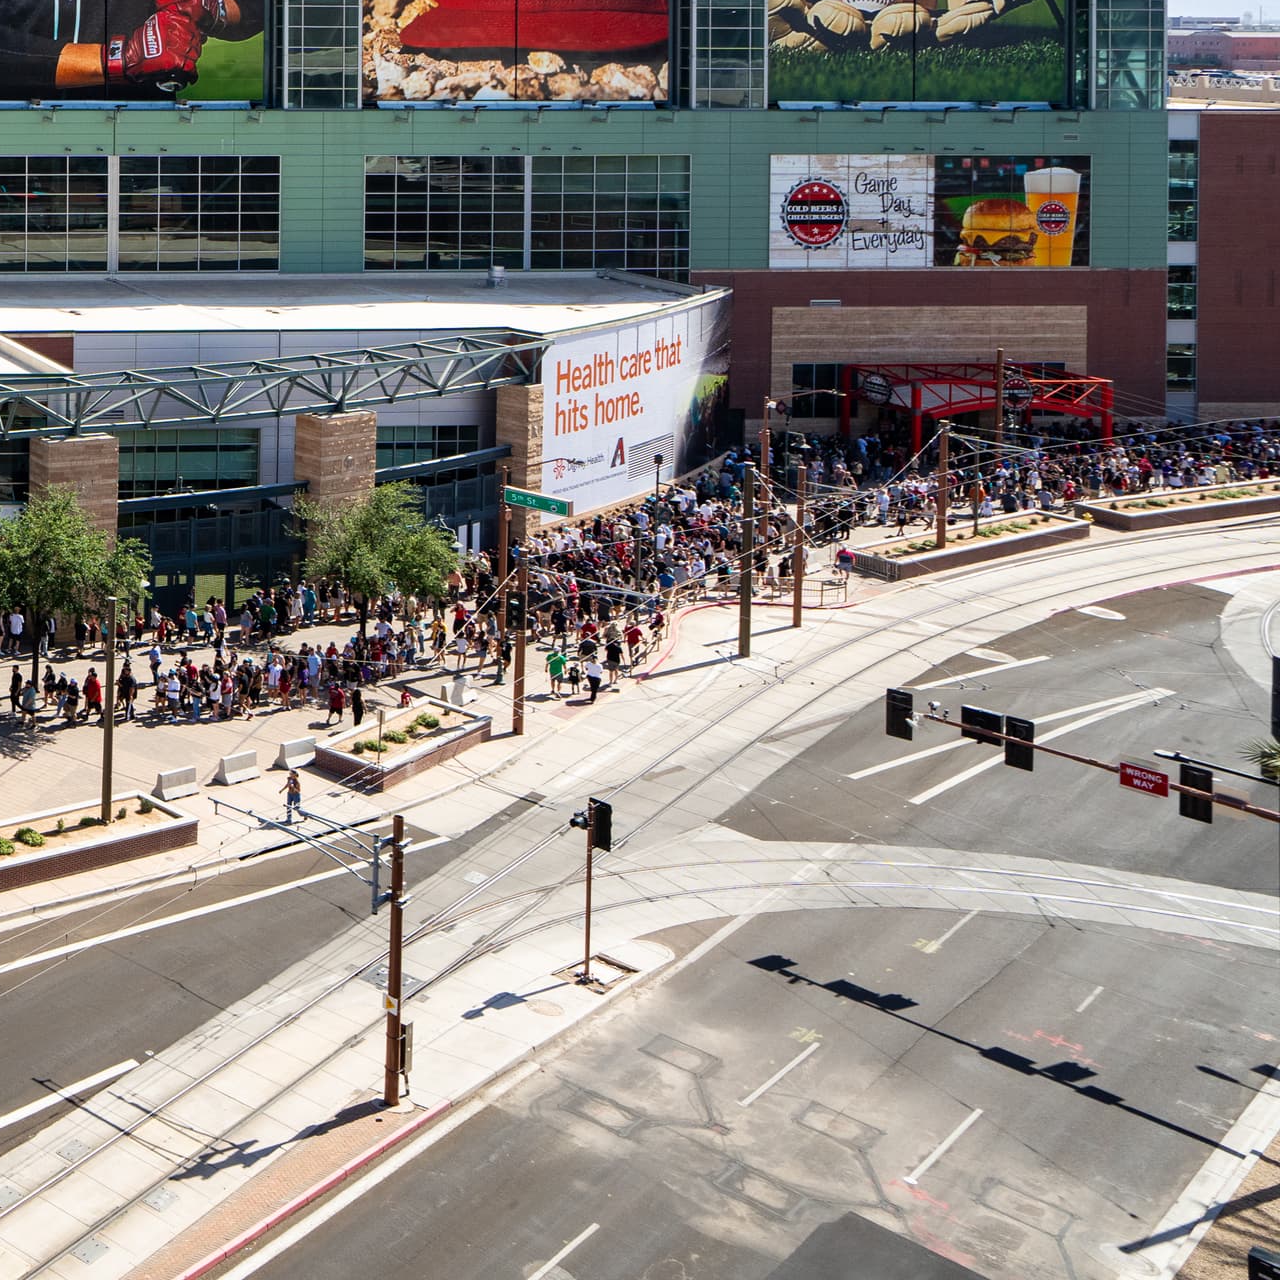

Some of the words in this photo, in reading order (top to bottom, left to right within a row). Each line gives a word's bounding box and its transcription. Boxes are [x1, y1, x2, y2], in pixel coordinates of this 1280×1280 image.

[854, 172, 898, 194] Game
[878, 192, 927, 217] Day
[851, 225, 925, 253] Everyday
[556, 351, 615, 395] Health
[619, 349, 652, 381] care
[655, 334, 682, 371] that
[555, 399, 589, 436] hits
[595, 391, 644, 426] home.
[1126, 767, 1162, 783] WRONG
[1133, 778, 1155, 789] WAY
